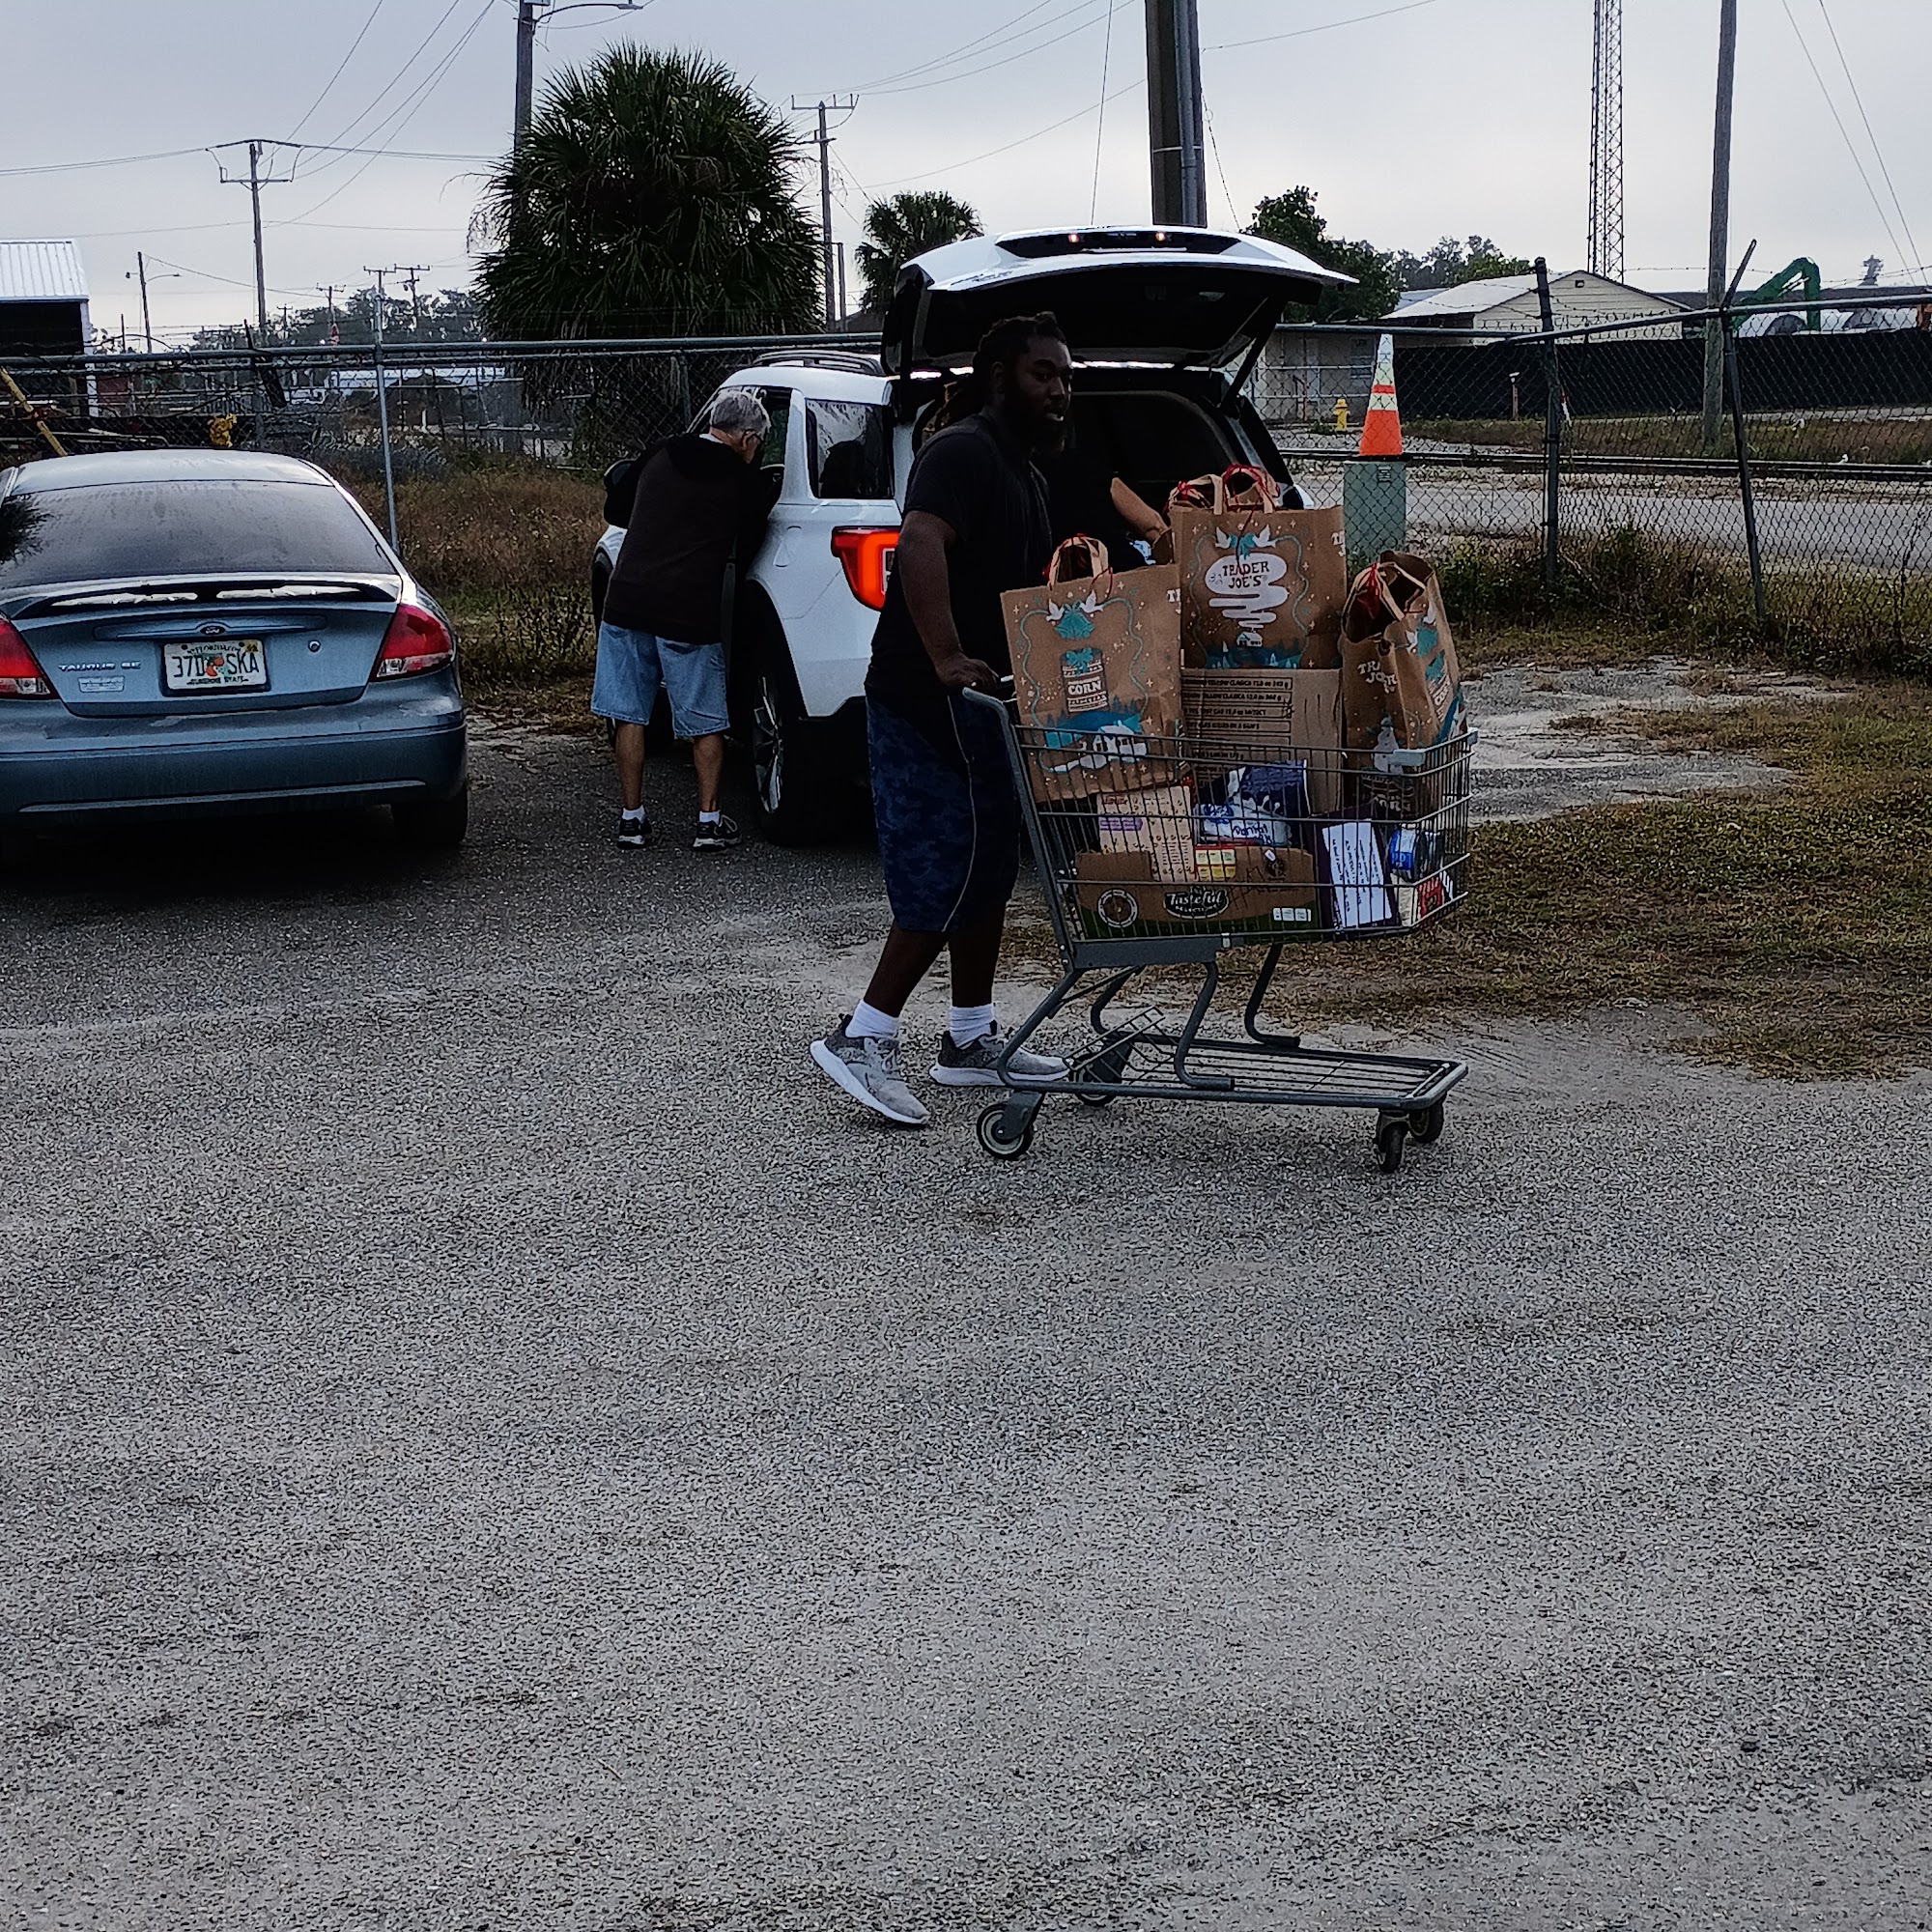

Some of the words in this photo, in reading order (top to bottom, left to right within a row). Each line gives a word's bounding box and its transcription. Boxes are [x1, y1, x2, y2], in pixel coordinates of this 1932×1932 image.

[1222, 560, 1269, 577] TRADER
[1228, 575, 1262, 589] JOE'S
[58, 663, 116, 672] TAURUS
[121, 661, 141, 669] SE
[226, 651, 259, 675] SKA
[1067, 679, 1102, 696] CORN
[1166, 891, 1223, 905] Tasteful
